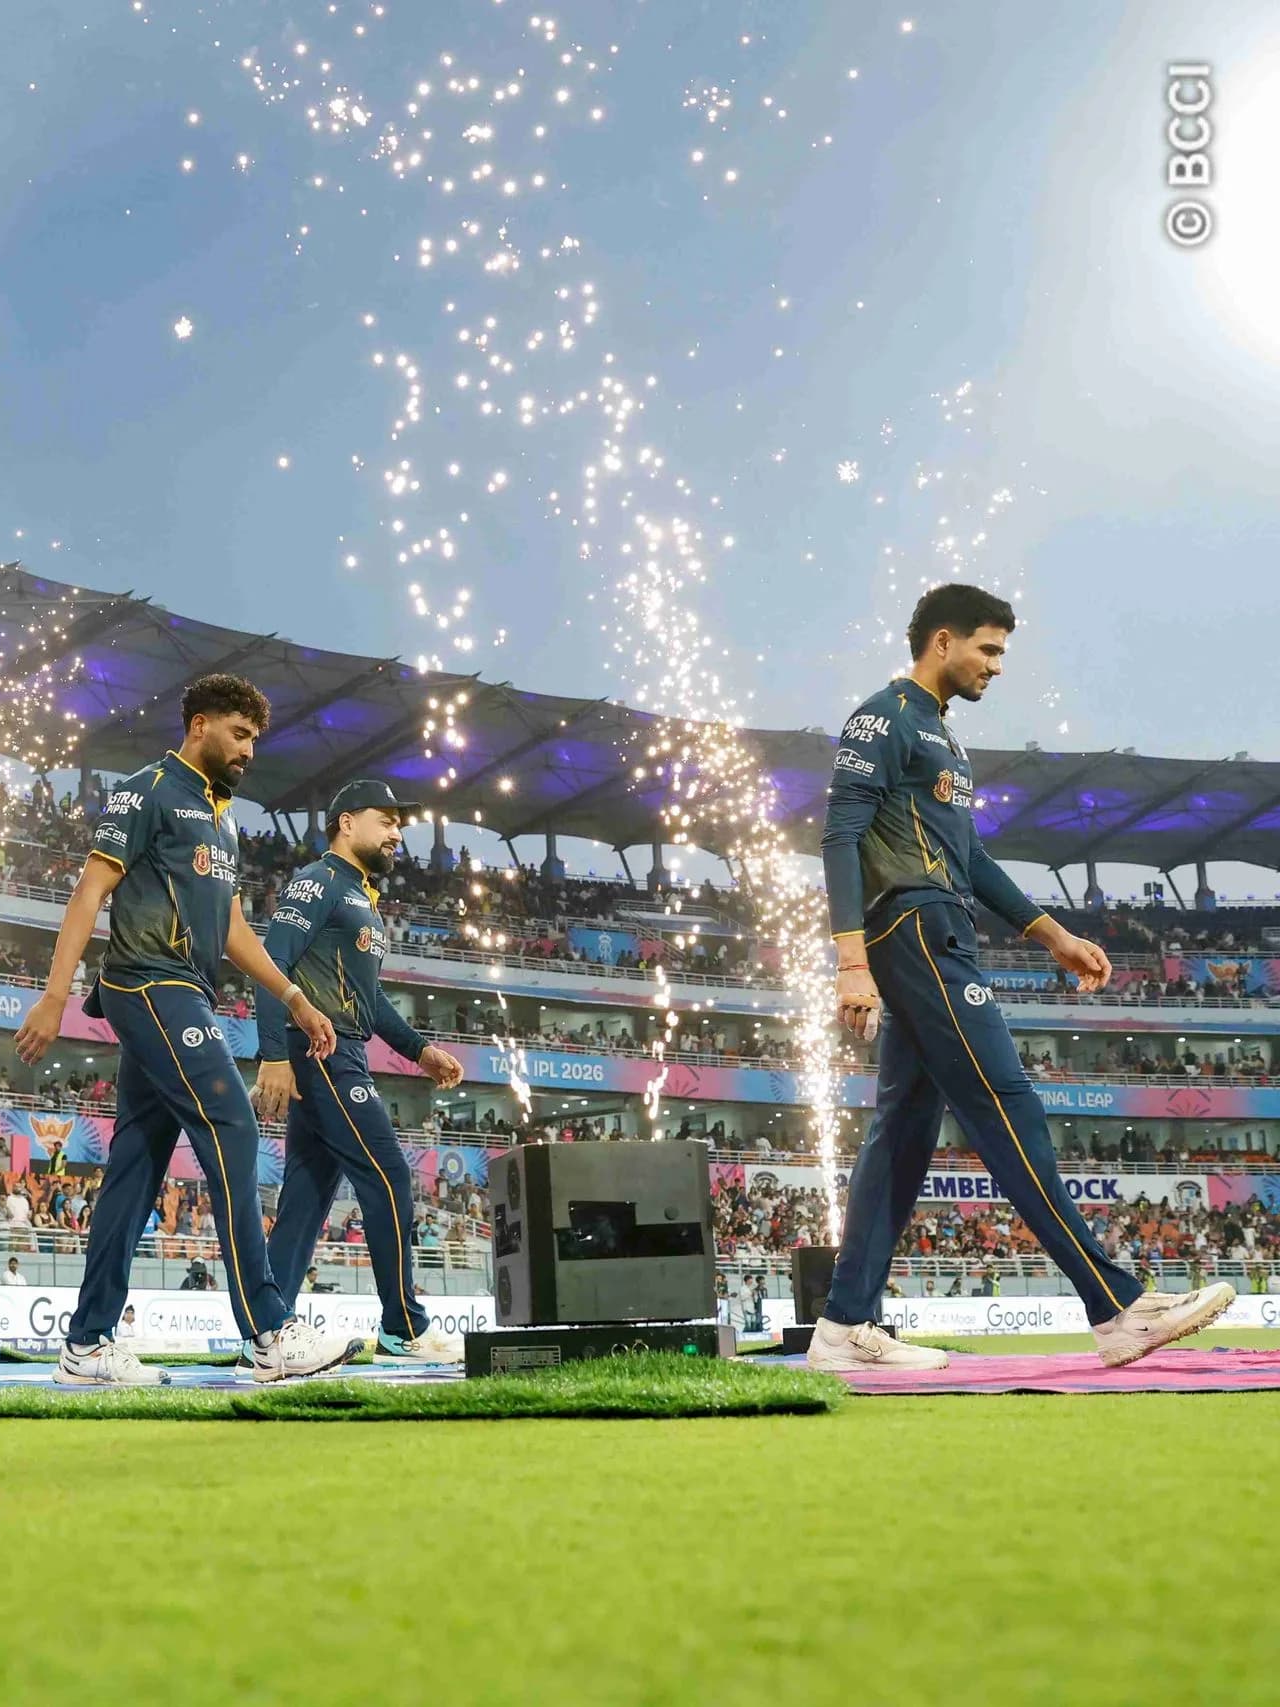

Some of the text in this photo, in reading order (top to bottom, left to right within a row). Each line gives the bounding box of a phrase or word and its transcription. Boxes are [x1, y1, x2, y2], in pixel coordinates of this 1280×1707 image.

[284, 880, 325, 900] ASTRAL
[286, 891, 314, 904] PIPES
[533, 1059, 559, 1079] IPL
[562, 1062, 604, 1082] 2026
[1077, 1091, 1114, 1108] LEAP
[1065, 1178, 1120, 1200] OCK
[170, 1314, 222, 1332] AI Mode
[986, 1303, 1053, 1328] Google
